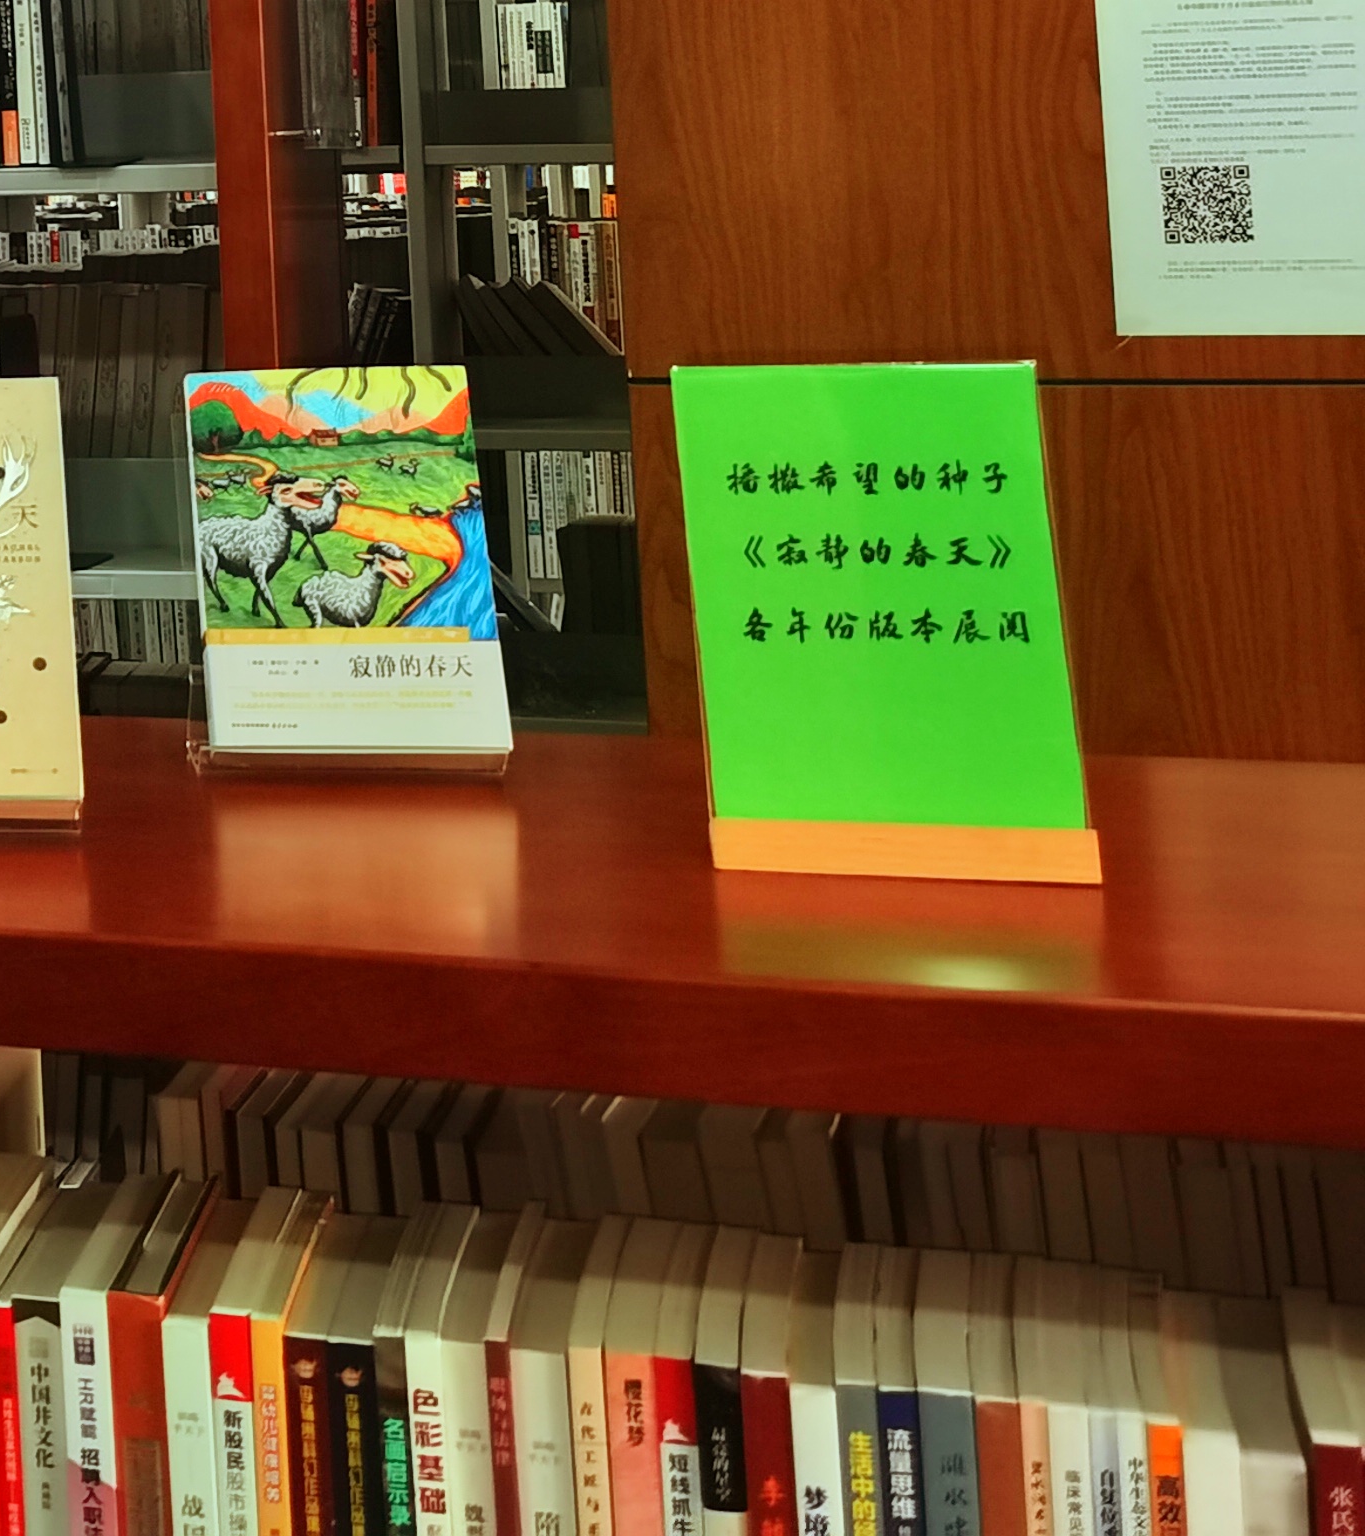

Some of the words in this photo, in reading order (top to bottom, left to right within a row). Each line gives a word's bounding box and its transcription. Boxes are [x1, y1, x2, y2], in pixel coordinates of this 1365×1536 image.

[726, 459, 1008, 496] 播撒希望的种子
[743, 532, 1012, 569] 《寂静的春天》
[742, 606, 1032, 646] 各年份版本展阅
[349, 654, 473, 679] 寂静的春天
[30, 1362, 55, 1469] 中国井文化
[624, 1379, 646, 1447] 樱花梦
[413, 1388, 447, 1517] 色彩基础
[886, 1428, 917, 1520] 流量思维
[1065, 1469, 1085, 1536] 临床常见
